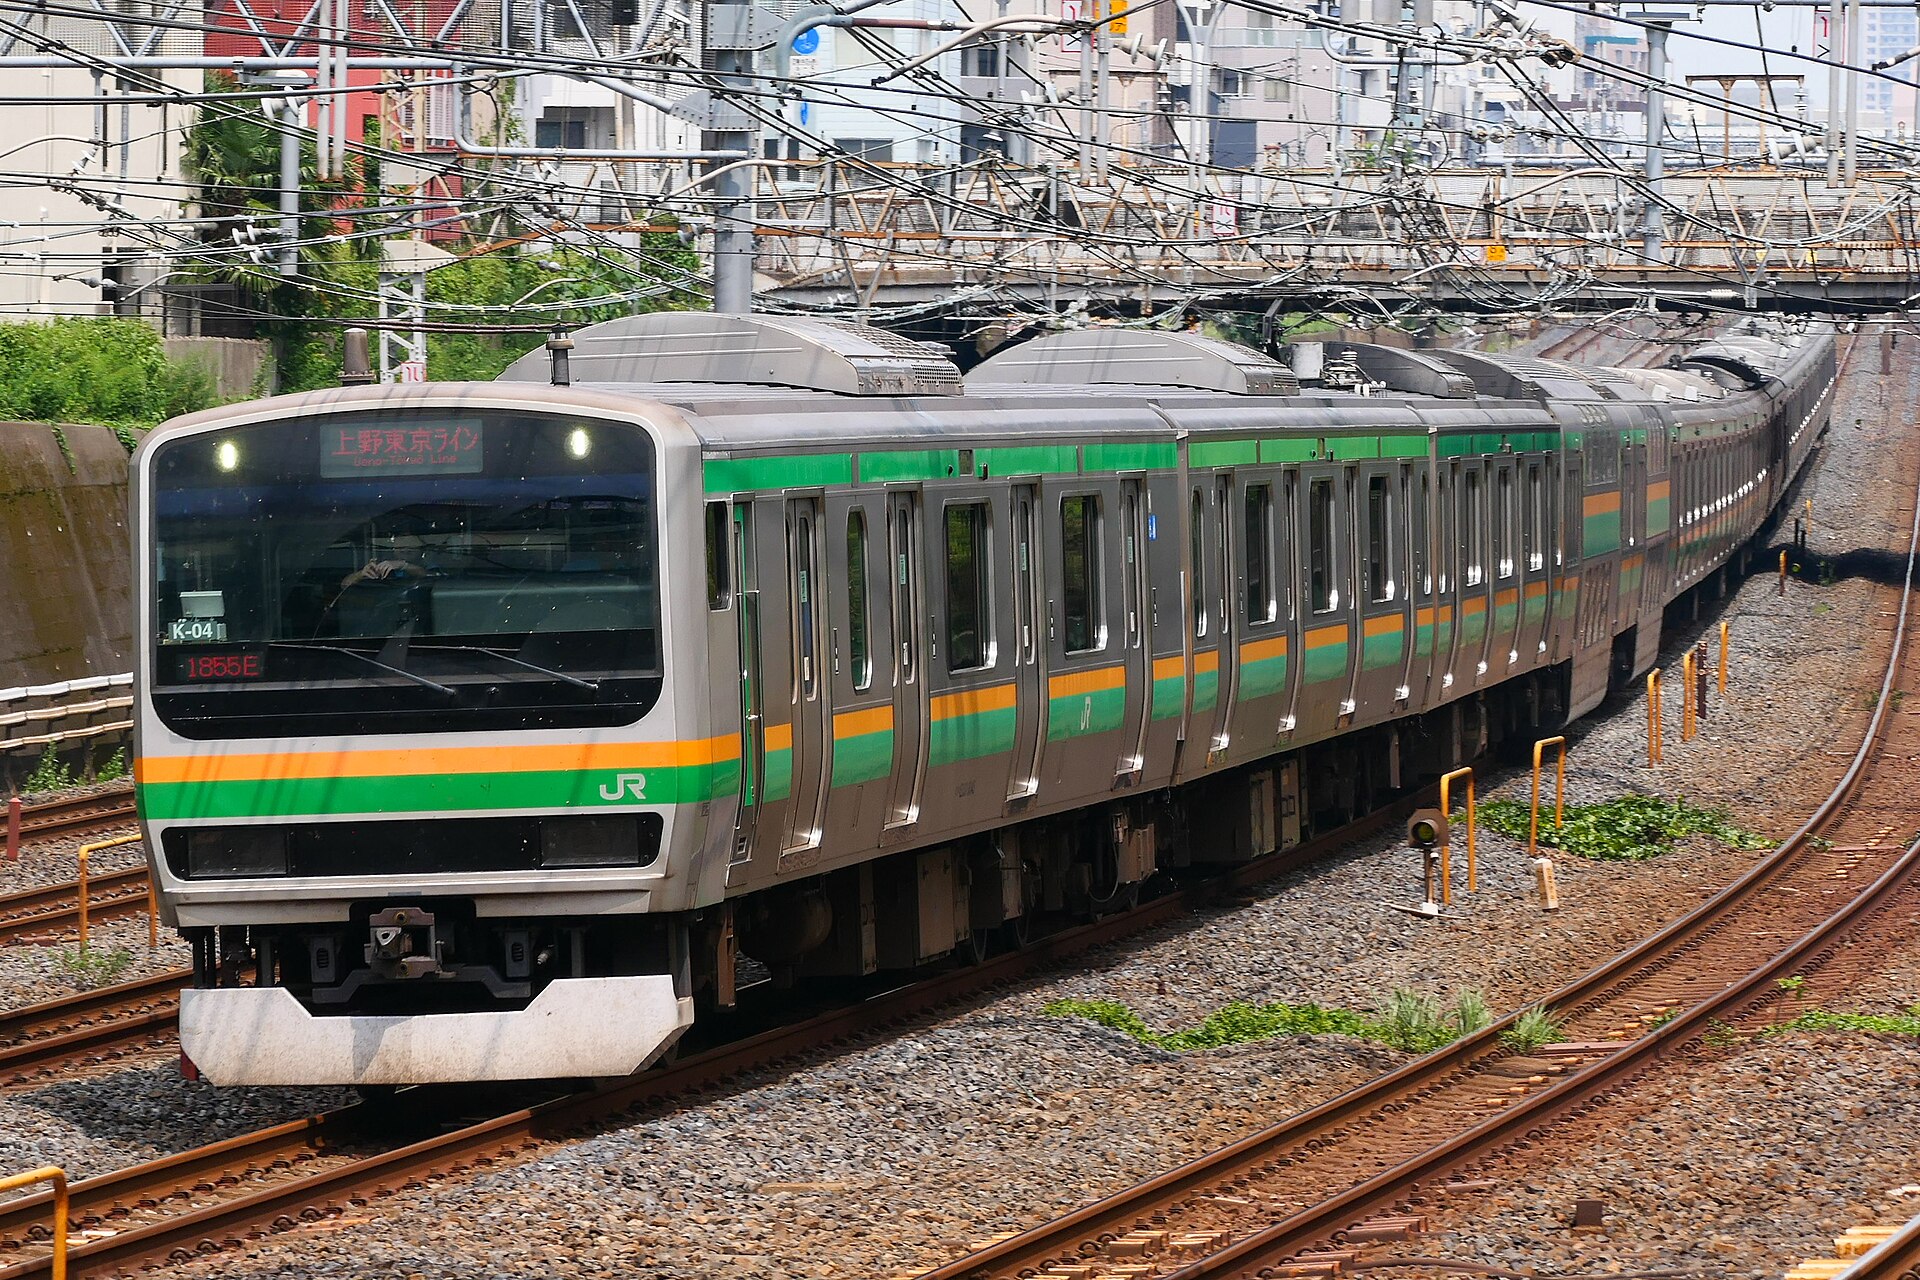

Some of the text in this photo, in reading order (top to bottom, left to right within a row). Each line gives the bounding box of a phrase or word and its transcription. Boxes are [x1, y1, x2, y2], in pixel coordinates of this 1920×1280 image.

[332, 425, 479, 455] 上野東京ライン
[430, 454, 458, 464] Line
[173, 623, 213, 639] K-04
[188, 656, 260, 677] 1855E
[599, 773, 647, 801] JR
